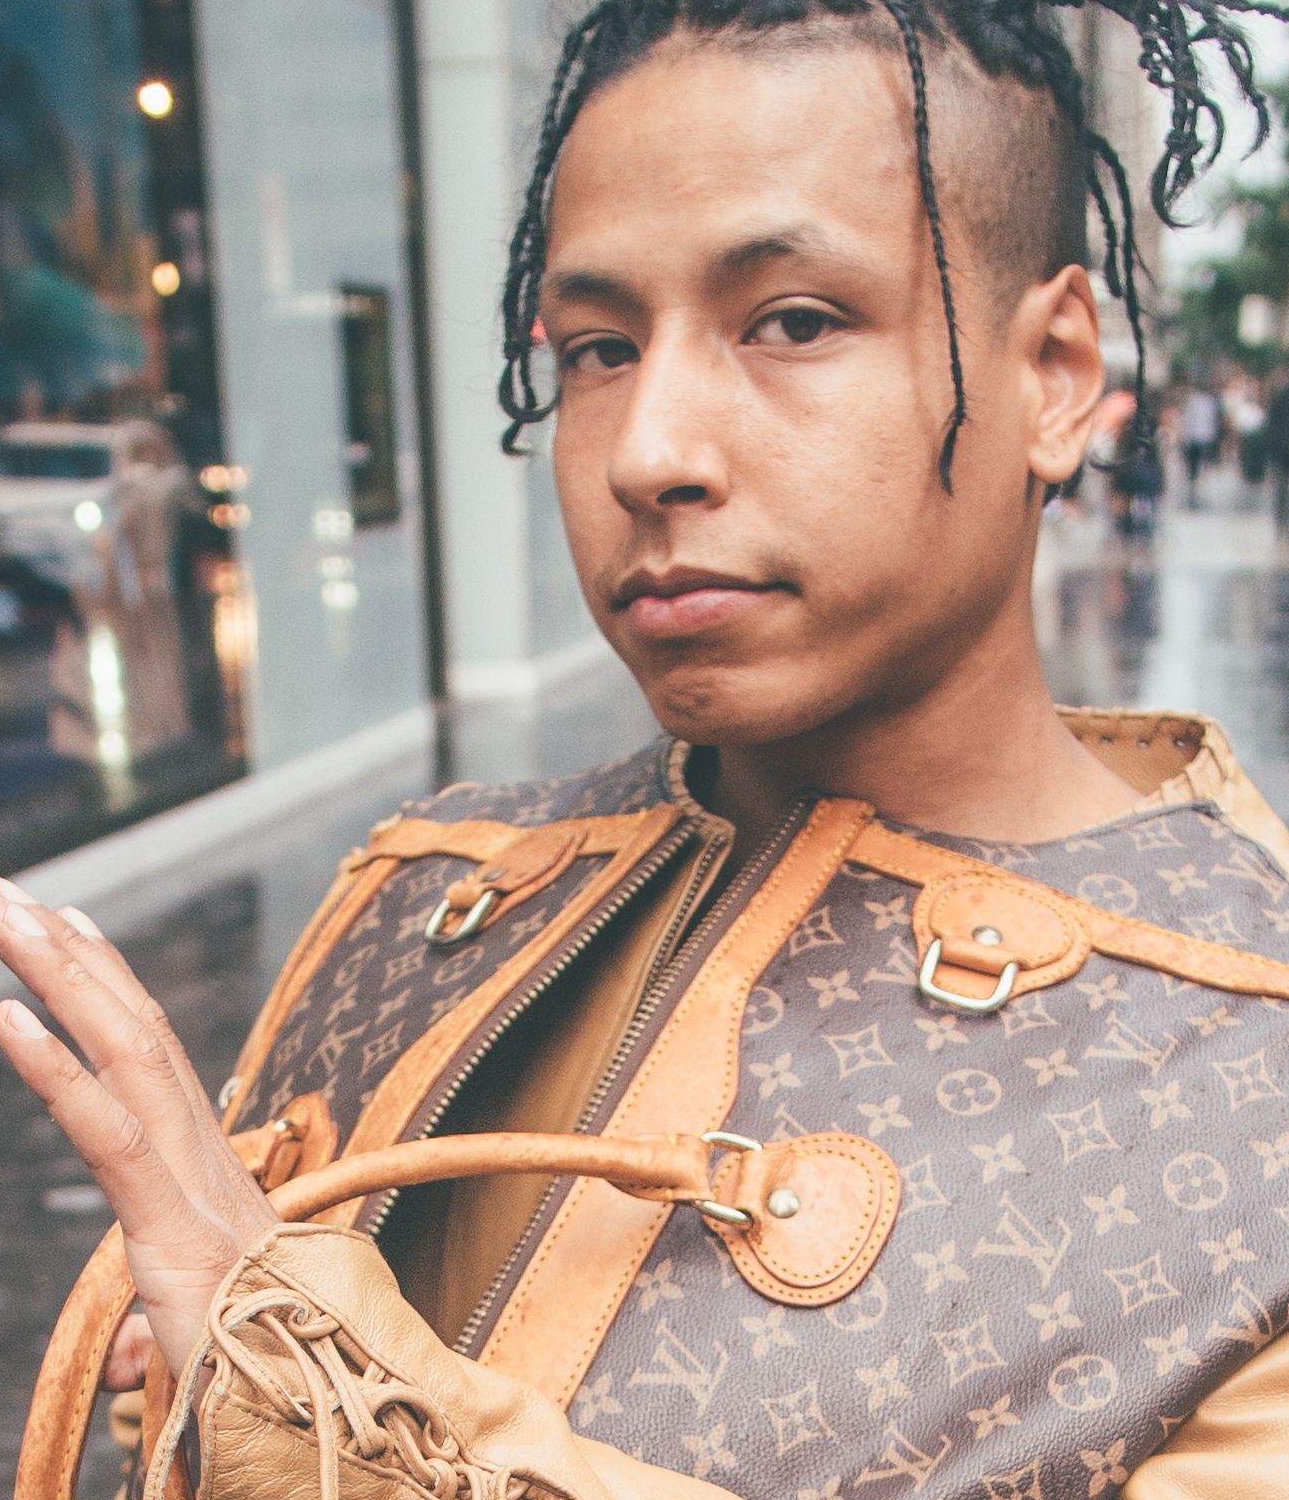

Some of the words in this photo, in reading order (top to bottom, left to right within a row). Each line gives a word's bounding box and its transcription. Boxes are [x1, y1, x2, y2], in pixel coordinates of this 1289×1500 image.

[1082, 1011, 1179, 1076] LV
[973, 1190, 1073, 1290] LV
[624, 1317, 729, 1417] LV
[853, 1424, 952, 1492] LV
